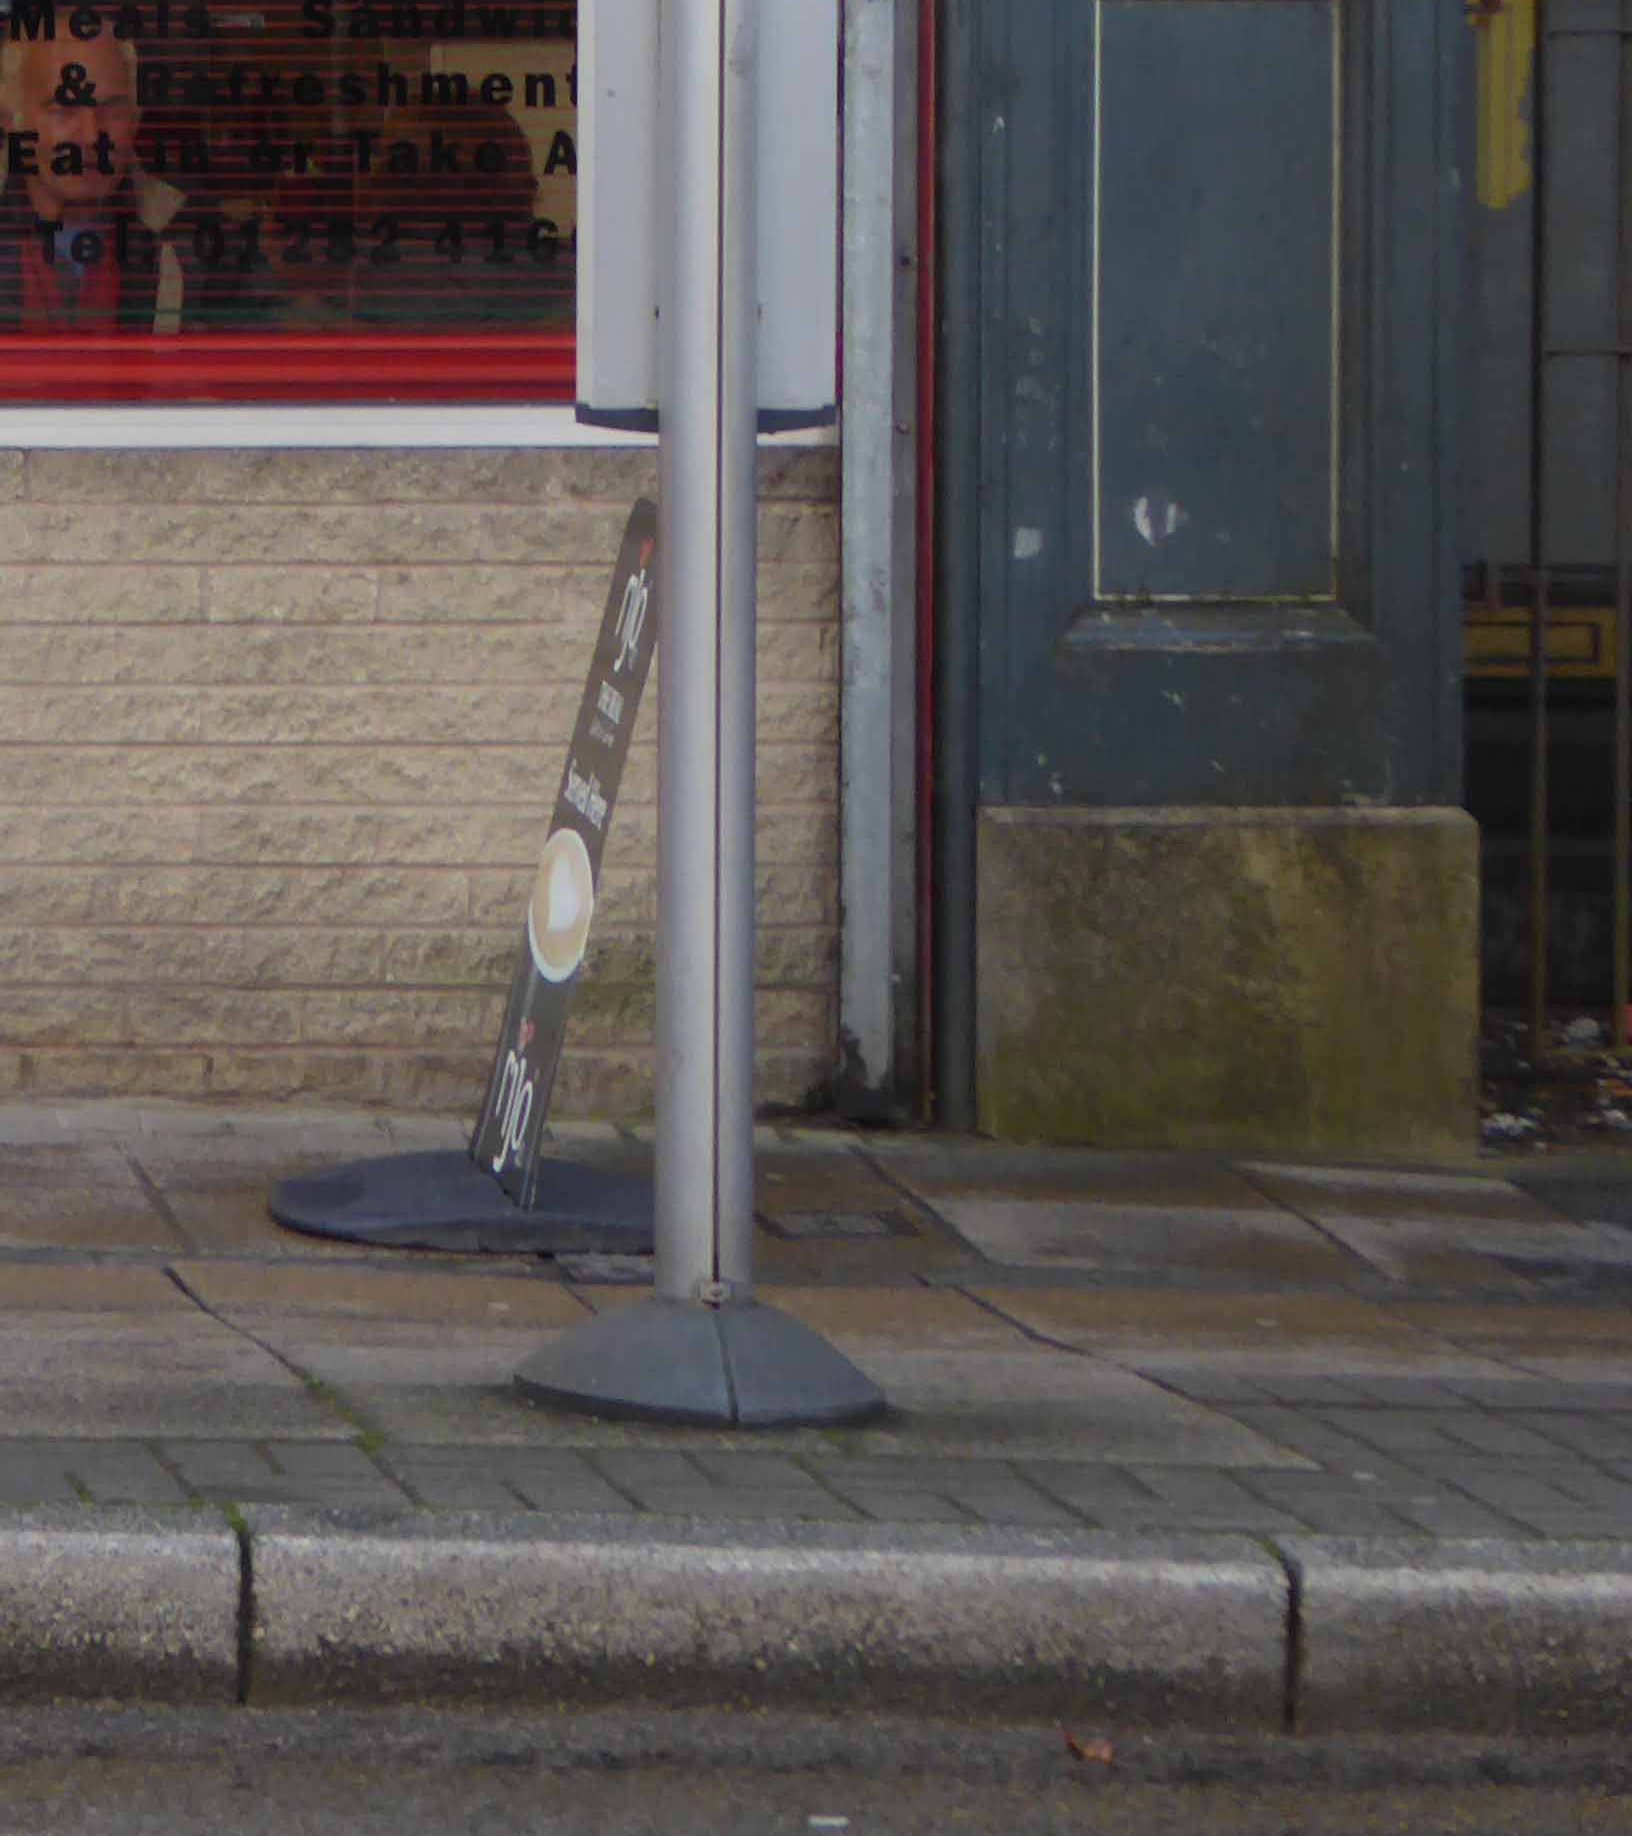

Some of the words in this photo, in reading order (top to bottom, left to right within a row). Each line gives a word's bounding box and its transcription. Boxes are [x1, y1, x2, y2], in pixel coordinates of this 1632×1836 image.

[54, 64, 97, 107] &
[7, 130, 116, 176] Eat
[348, 129, 507, 174] Take
